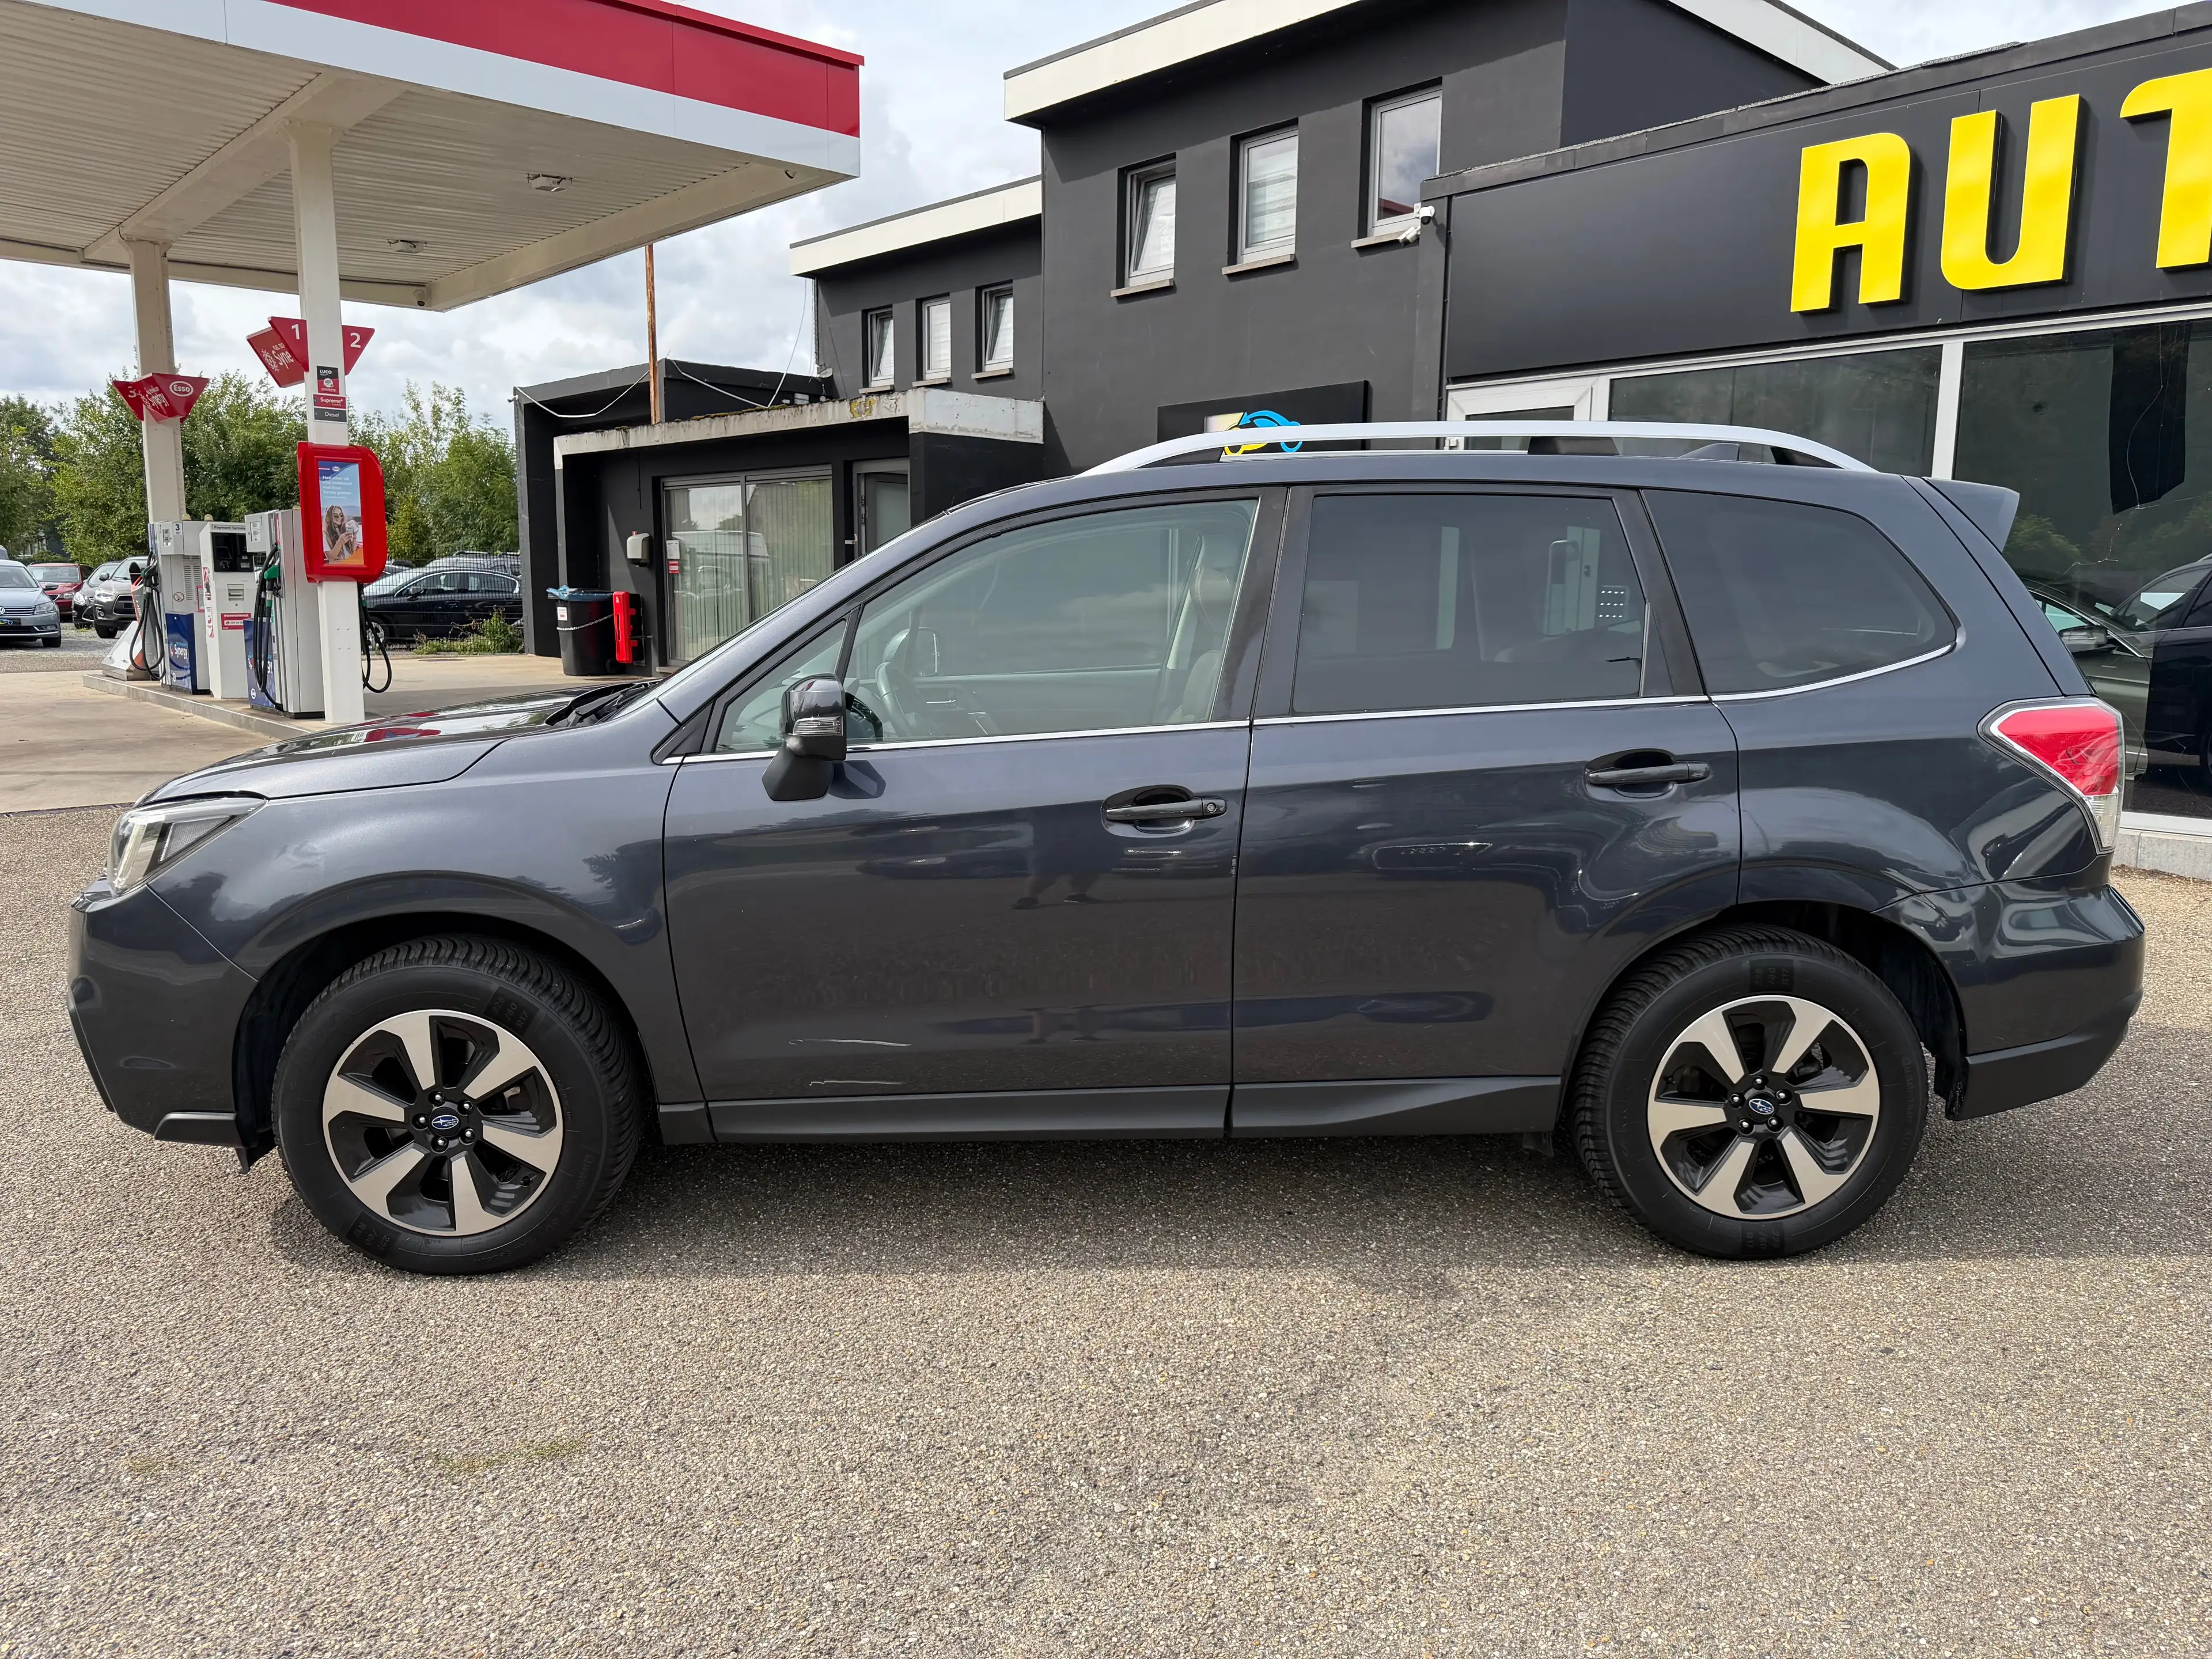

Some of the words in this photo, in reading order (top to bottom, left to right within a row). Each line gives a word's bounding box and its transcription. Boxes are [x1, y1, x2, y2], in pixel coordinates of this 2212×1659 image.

[291, 324, 300, 340] 1
[350, 332, 362, 349] 2
[128, 385, 137, 398] 3
[173, 384, 191, 392] Esso
[174, 643, 188, 660] Synergy
[516, 1009, 528, 1028] R17
